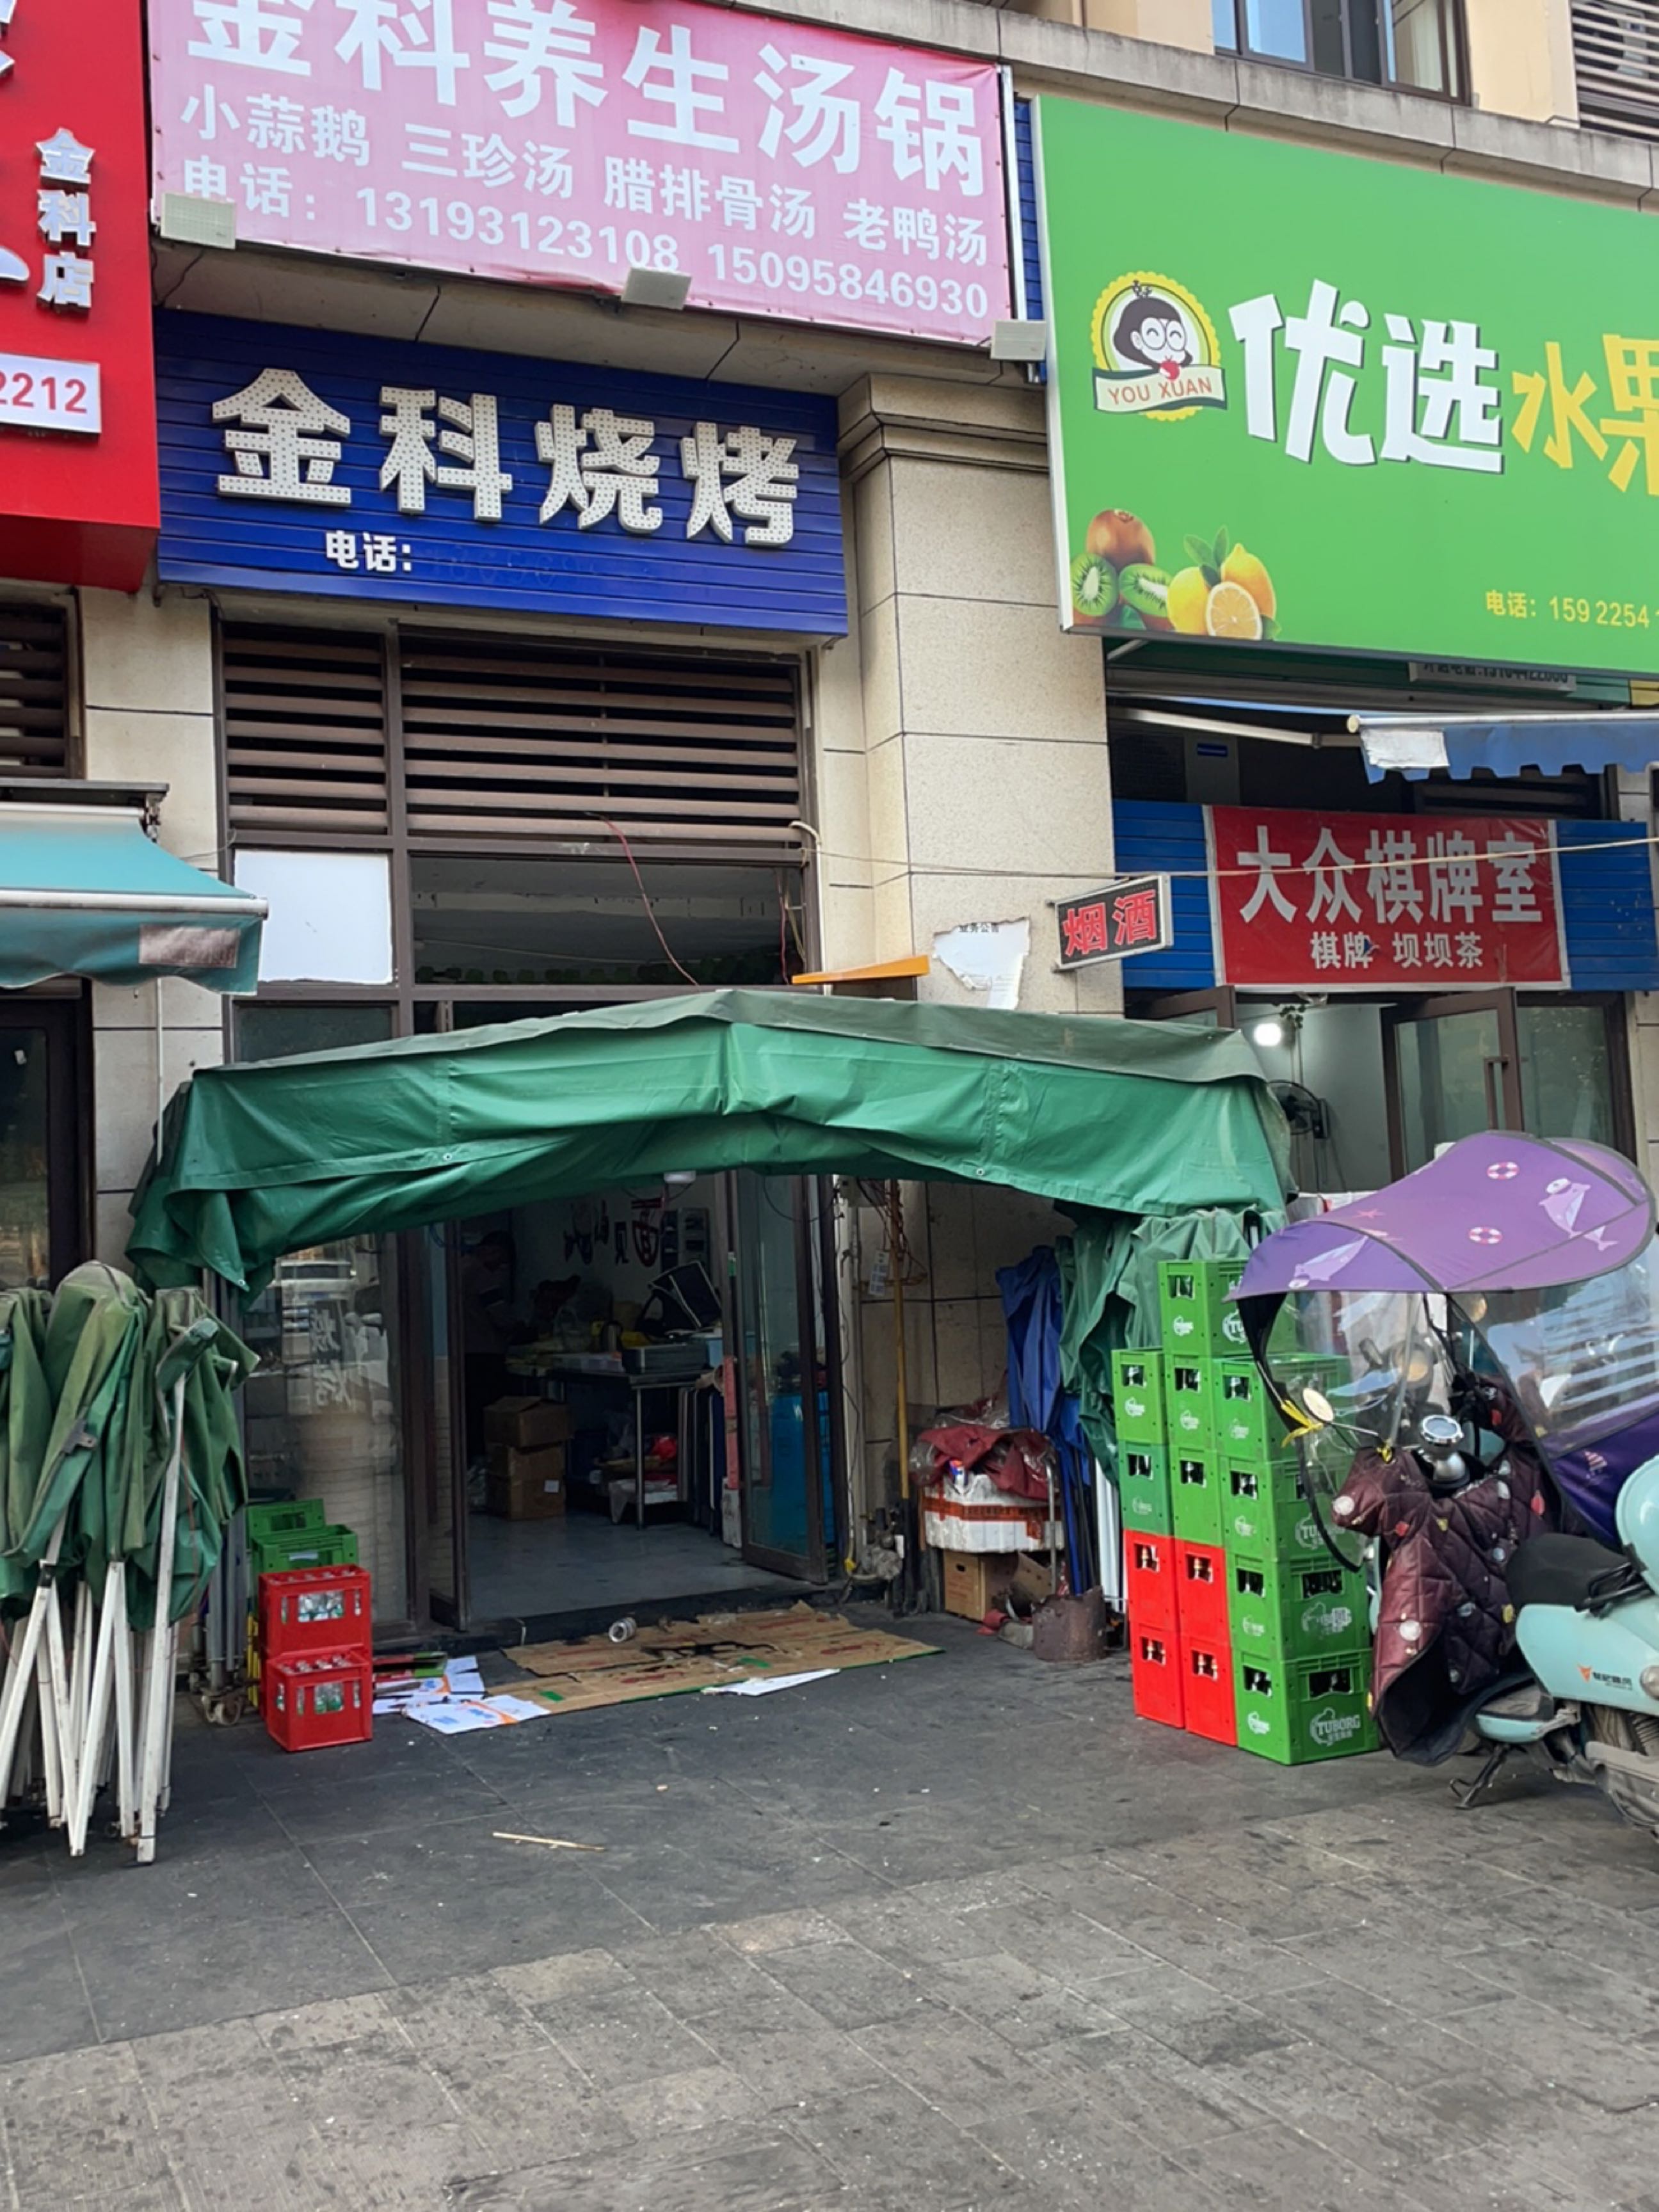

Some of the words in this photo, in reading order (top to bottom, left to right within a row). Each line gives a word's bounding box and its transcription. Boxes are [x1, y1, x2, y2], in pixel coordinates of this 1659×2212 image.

[187, 0, 984, 197] 金科养生汤锅
[36, 127, 97, 309] 金科店
[180, 84, 370, 167] 小蒜鹅
[401, 124, 573, 198] 三珍汤
[604, 156, 815, 240] 腊排骨汤
[843, 198, 988, 268] 老鸭汤
[356, 188, 679, 271] 13193123108
[707, 243, 988, 319] 15095846930
[1109, 384, 1150, 405] YOU
[1158, 378, 1212, 399] XUAN
[211, 367, 799, 549] 金科烧烤
[325, 530, 412, 572] 电话：
[1485, 589, 1536, 619] 电话：
[1062, 889, 1157, 958] 烟酒
[1236, 824, 1544, 925] 大众棋牌室
[1391, 931, 1484, 969] 坝坝茶
